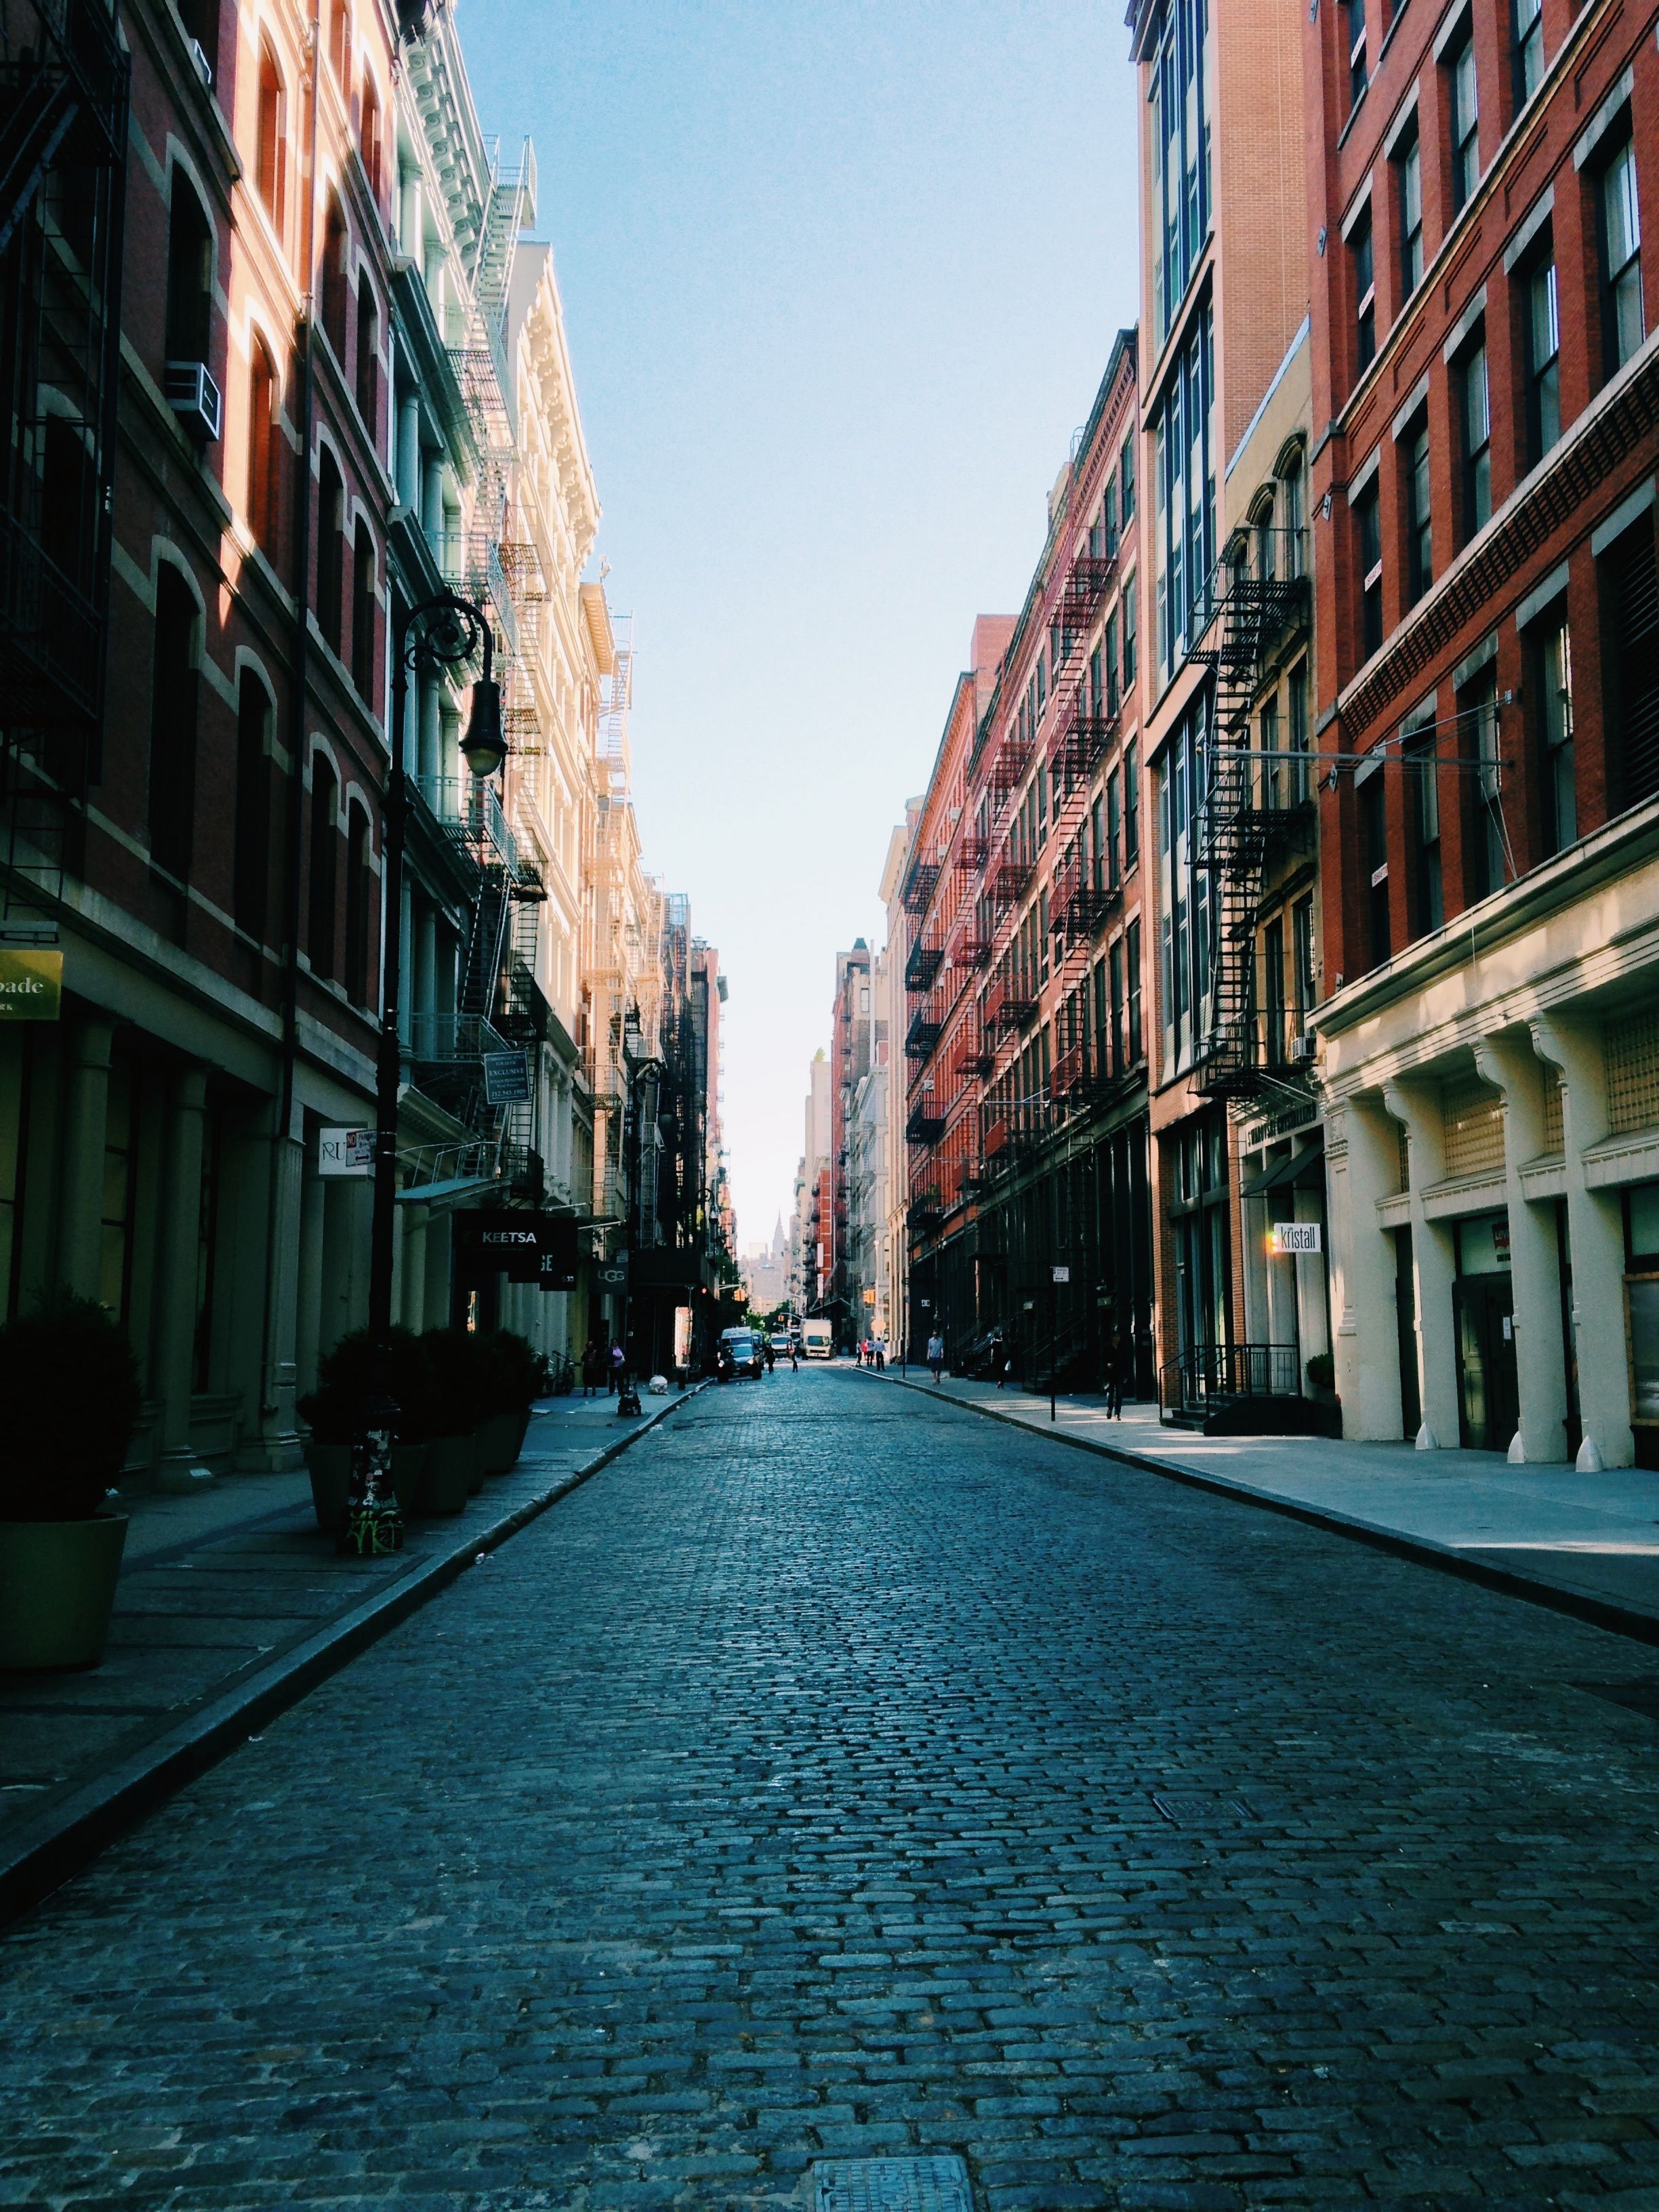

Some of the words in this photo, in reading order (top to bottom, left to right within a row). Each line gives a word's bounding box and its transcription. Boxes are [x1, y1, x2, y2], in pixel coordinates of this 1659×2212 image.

[489, 1068, 525, 1076] EXCLUSIVE
[483, 1231, 537, 1244] KEETSA
[1281, 1226, 1315, 1248] kristall
[598, 1269, 624, 1282] UGG
